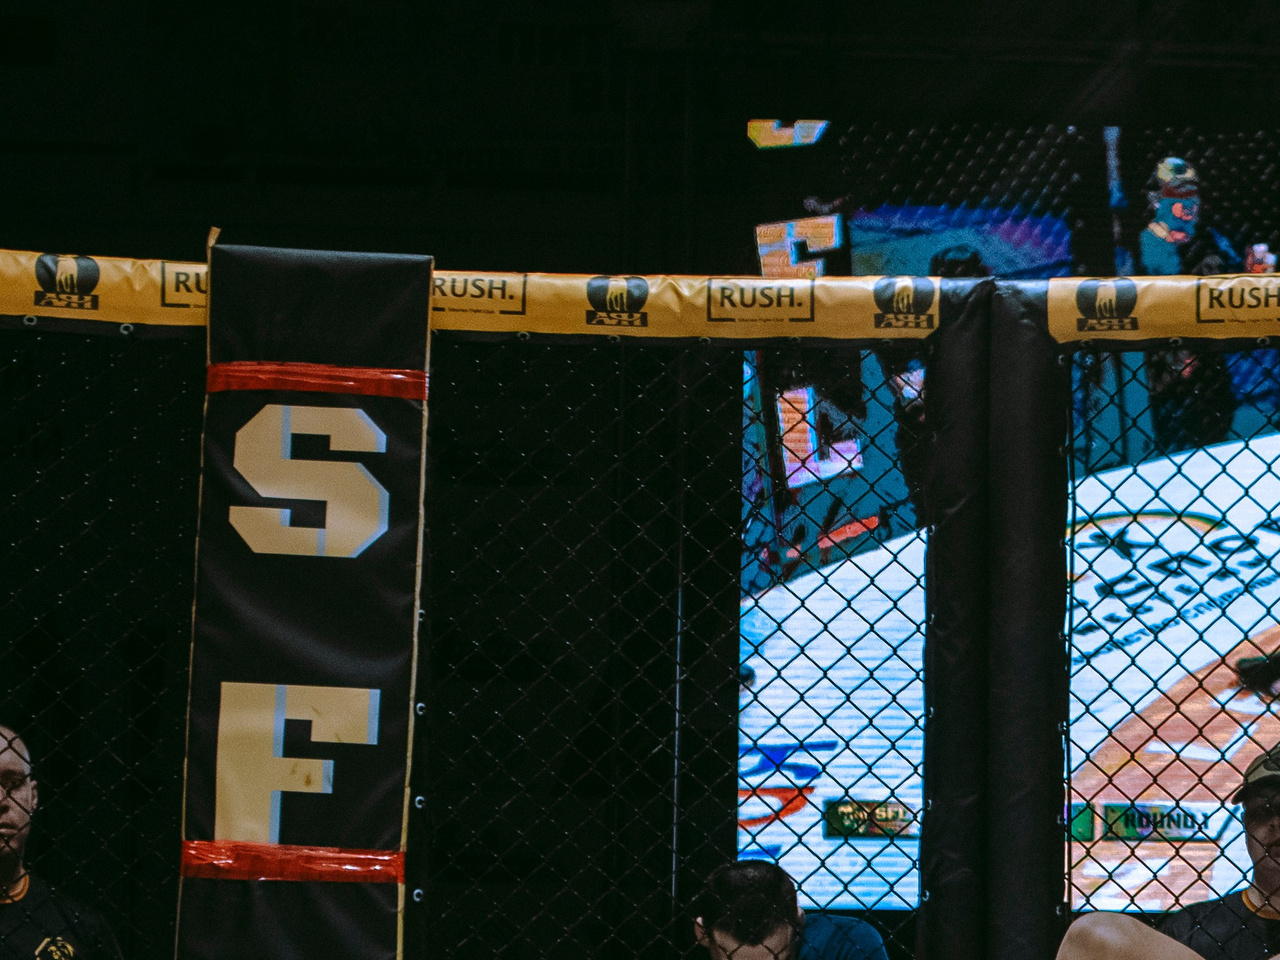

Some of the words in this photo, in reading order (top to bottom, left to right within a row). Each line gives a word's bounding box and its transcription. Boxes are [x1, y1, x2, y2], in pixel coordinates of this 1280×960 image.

[174, 271, 208, 294] RU
[717, 286, 802, 308] RUSH.
[1124, 812, 1196, 829] ROUND
